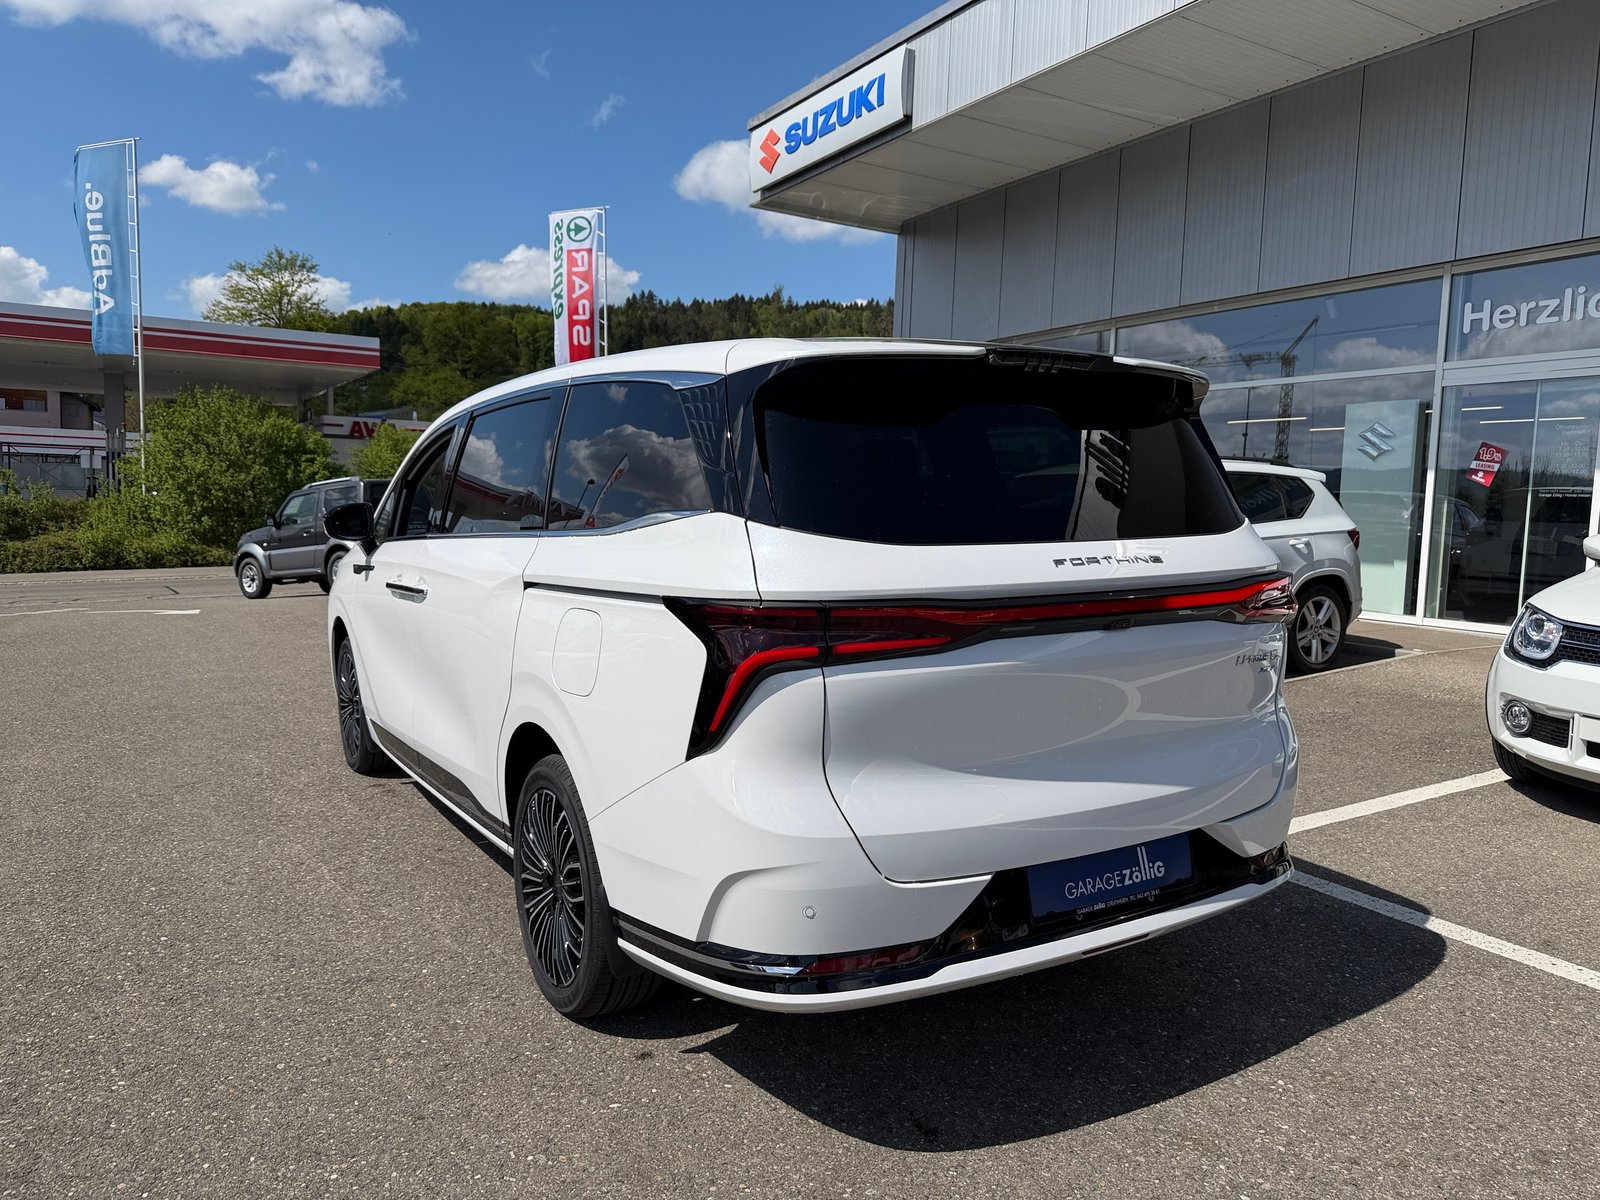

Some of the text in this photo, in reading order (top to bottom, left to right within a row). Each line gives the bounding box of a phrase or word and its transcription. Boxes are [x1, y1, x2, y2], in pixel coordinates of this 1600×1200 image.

[784, 72, 886, 155] SUZUKI
[1475, 462, 1495, 470] LEASING
[1052, 555, 1164, 568] FORTHING
[1065, 871, 1123, 899] GARAGE
